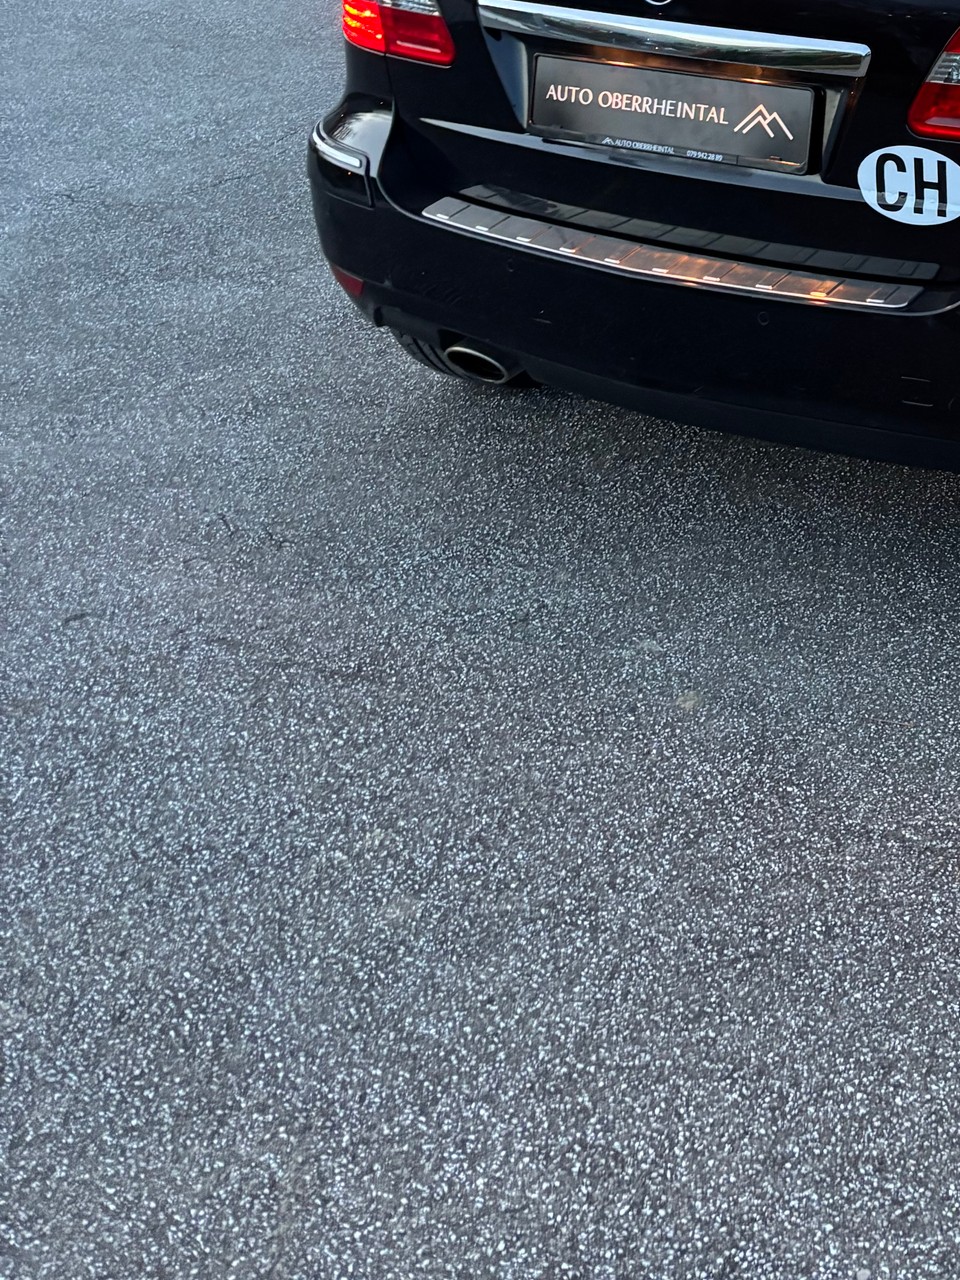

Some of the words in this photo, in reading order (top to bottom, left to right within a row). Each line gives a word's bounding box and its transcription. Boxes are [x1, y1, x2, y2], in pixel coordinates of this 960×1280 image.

[546, 84, 594, 106] AUTO
[598, 91, 729, 125] OBERRHEINTAL
[615, 139, 632, 148] AUTO
[875, 152, 948, 218] CH
